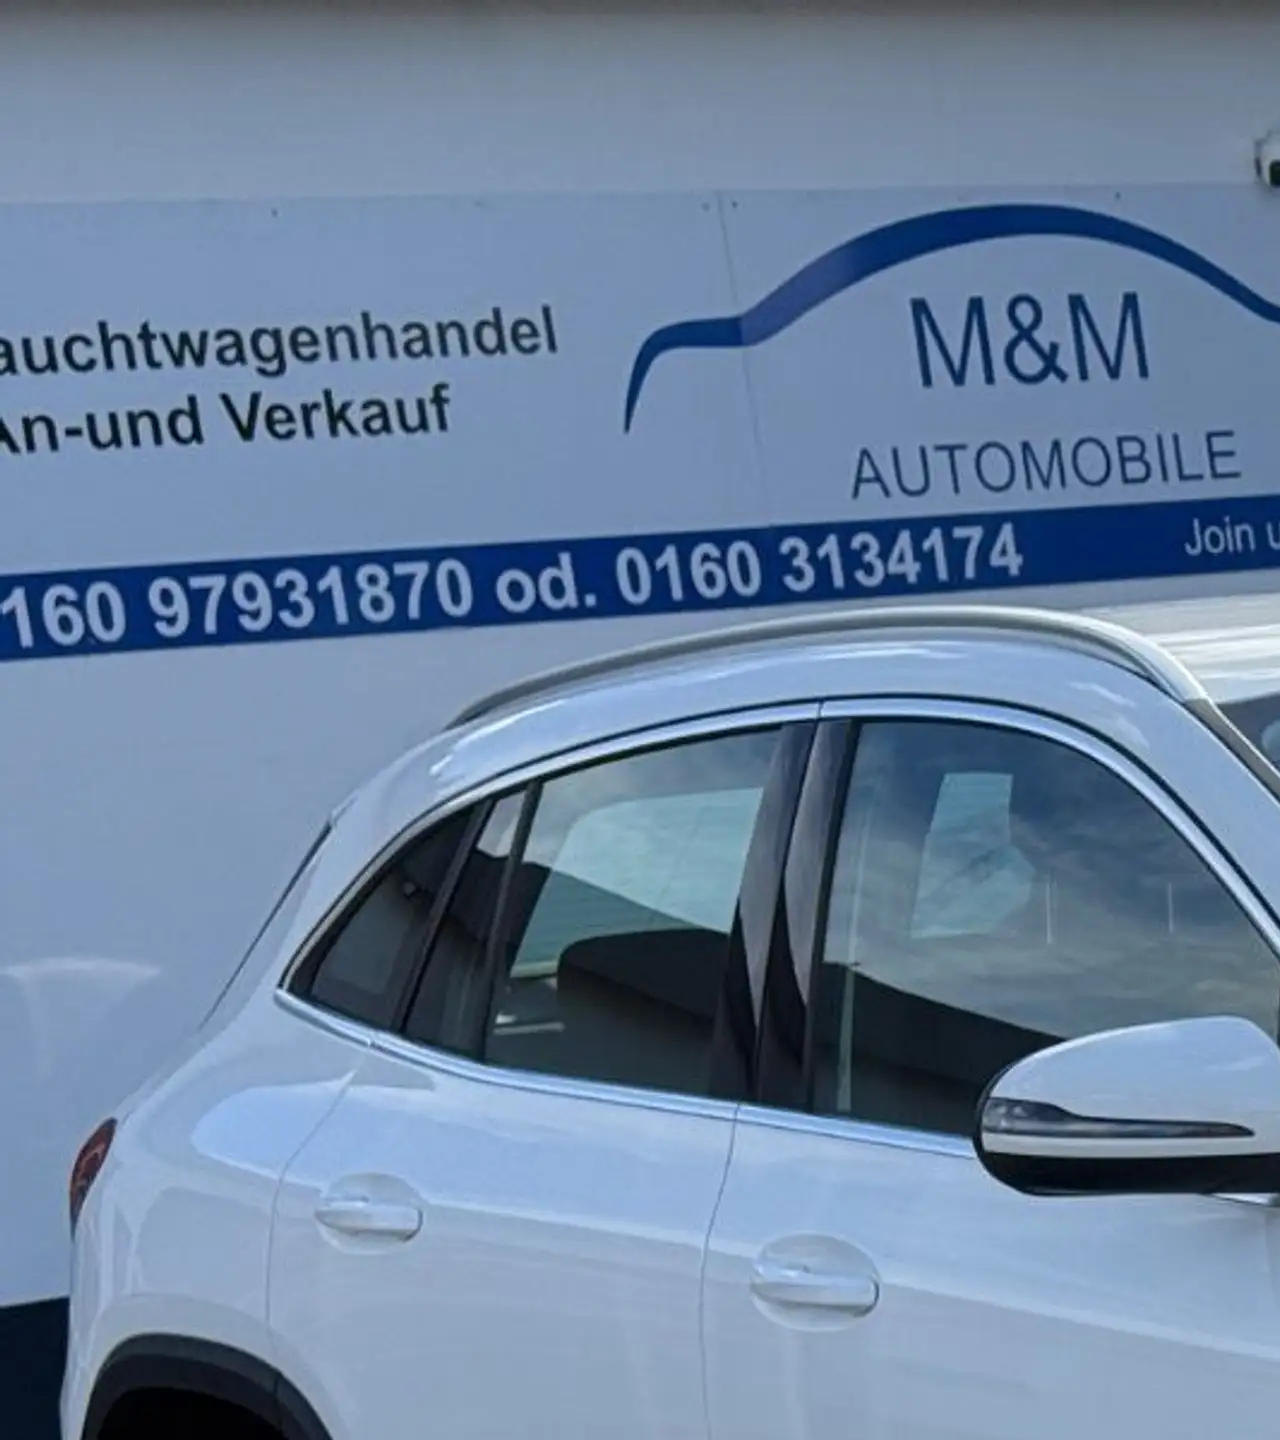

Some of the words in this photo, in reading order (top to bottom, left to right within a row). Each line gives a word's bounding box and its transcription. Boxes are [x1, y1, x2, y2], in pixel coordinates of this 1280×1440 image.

[910, 292, 1150, 389] M&M
[219, 383, 450, 442] Verkauf
[851, 430, 1242, 499] AUTOMOBILE
[1184, 514, 1256, 556] Join
[0, 580, 126, 649] 160
[148, 558, 472, 638] 97931870
[495, 552, 597, 614] od.
[616, 540, 762, 599] 0160
[780, 522, 1024, 593] 3134174
